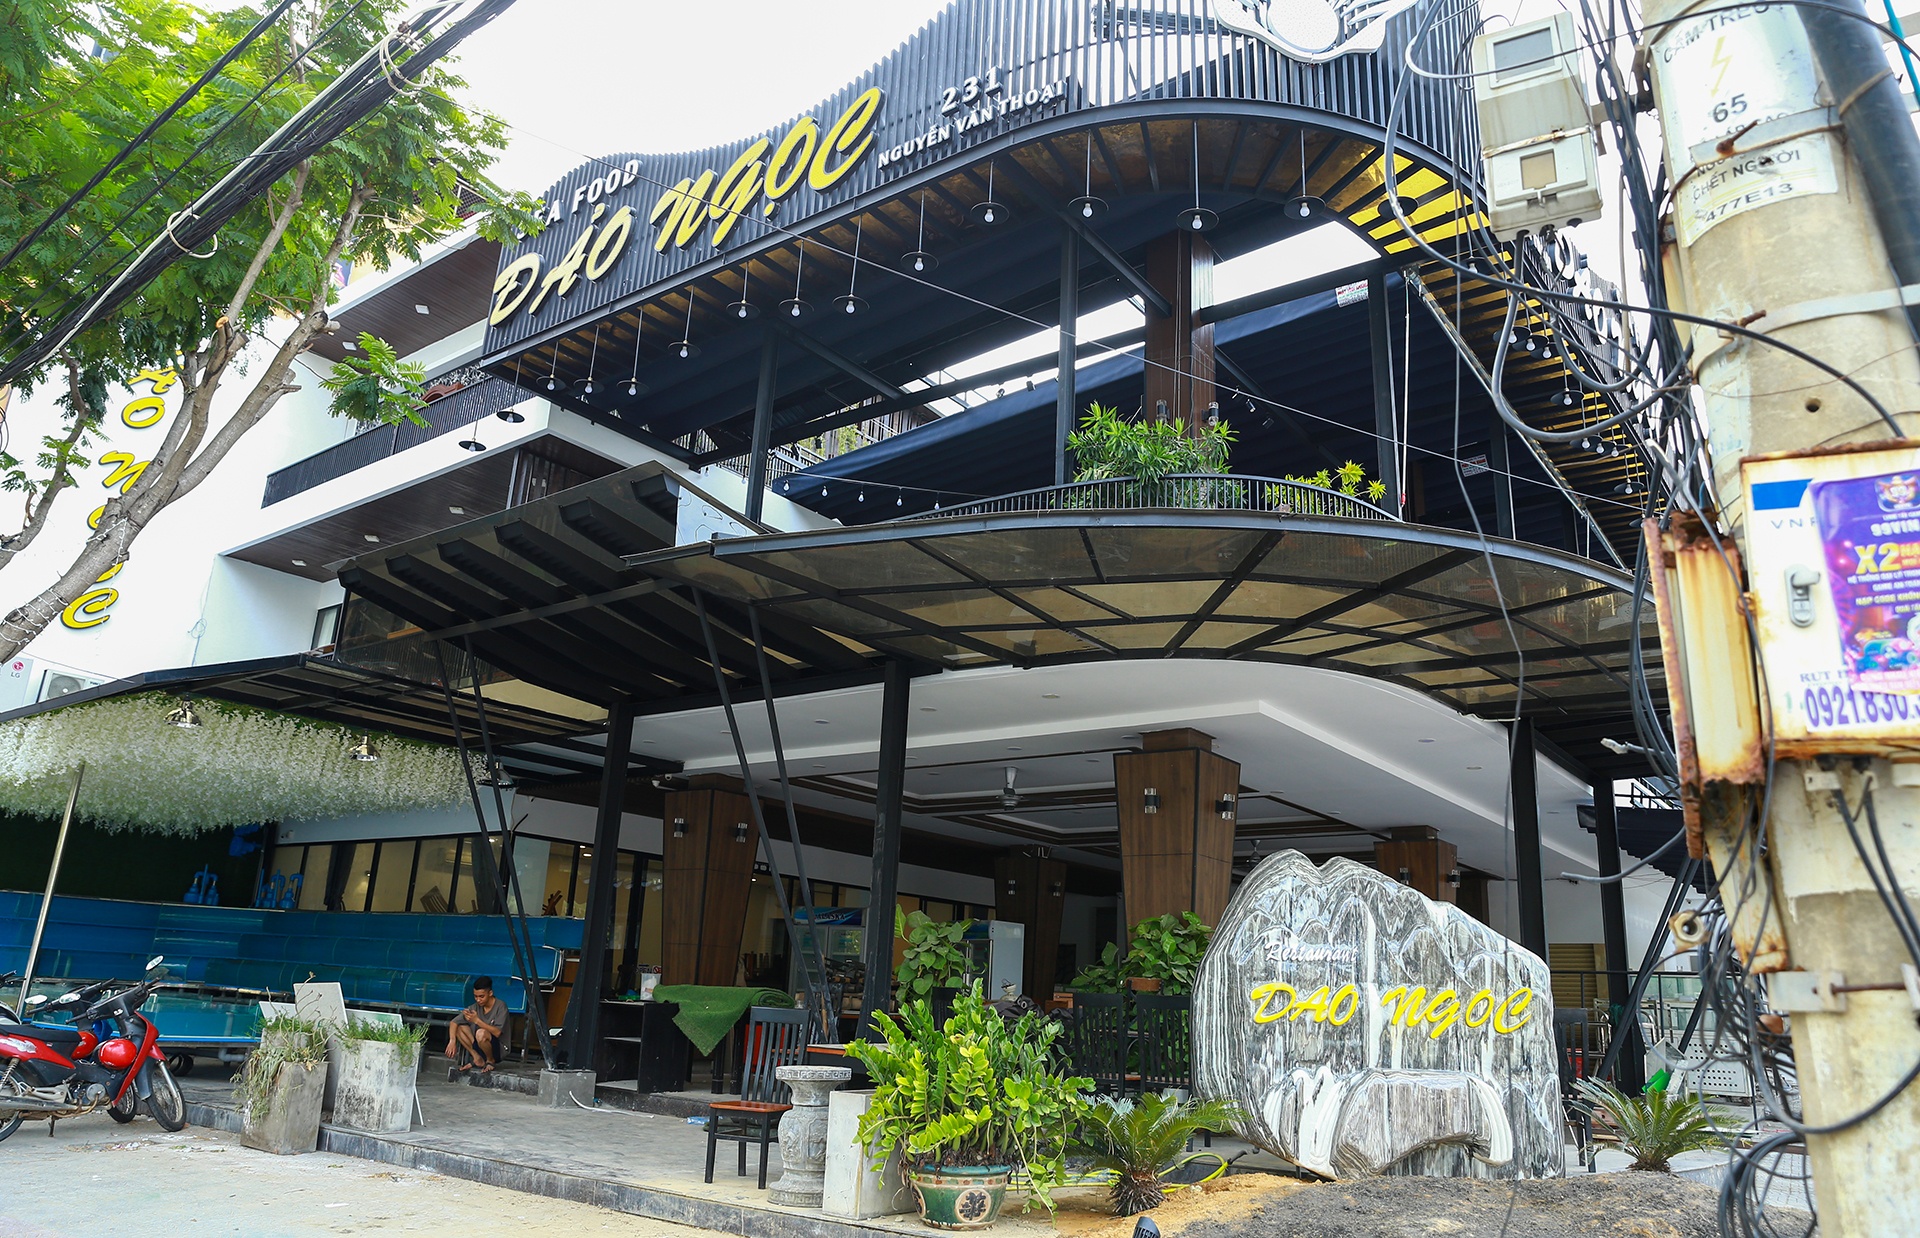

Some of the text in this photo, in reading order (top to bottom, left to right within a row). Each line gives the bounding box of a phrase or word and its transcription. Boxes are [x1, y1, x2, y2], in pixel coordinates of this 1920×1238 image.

[942, 66, 1003, 117] 231
[1711, 93, 1749, 123] 65
[877, 79, 1067, 170] NGUYỄN VĂN THOẠI
[1732, 148, 1801, 178] NGỜI
[489, 86, 885, 327] ĐẢO NGỌC
[571, 159, 641, 216] FOOD
[1705, 182, 1794, 223] 477E13
[1854, 541, 1902, 575] X2
[10, 671, 21, 679] LG
[1250, 982, 1533, 1039] DAO NGOC
